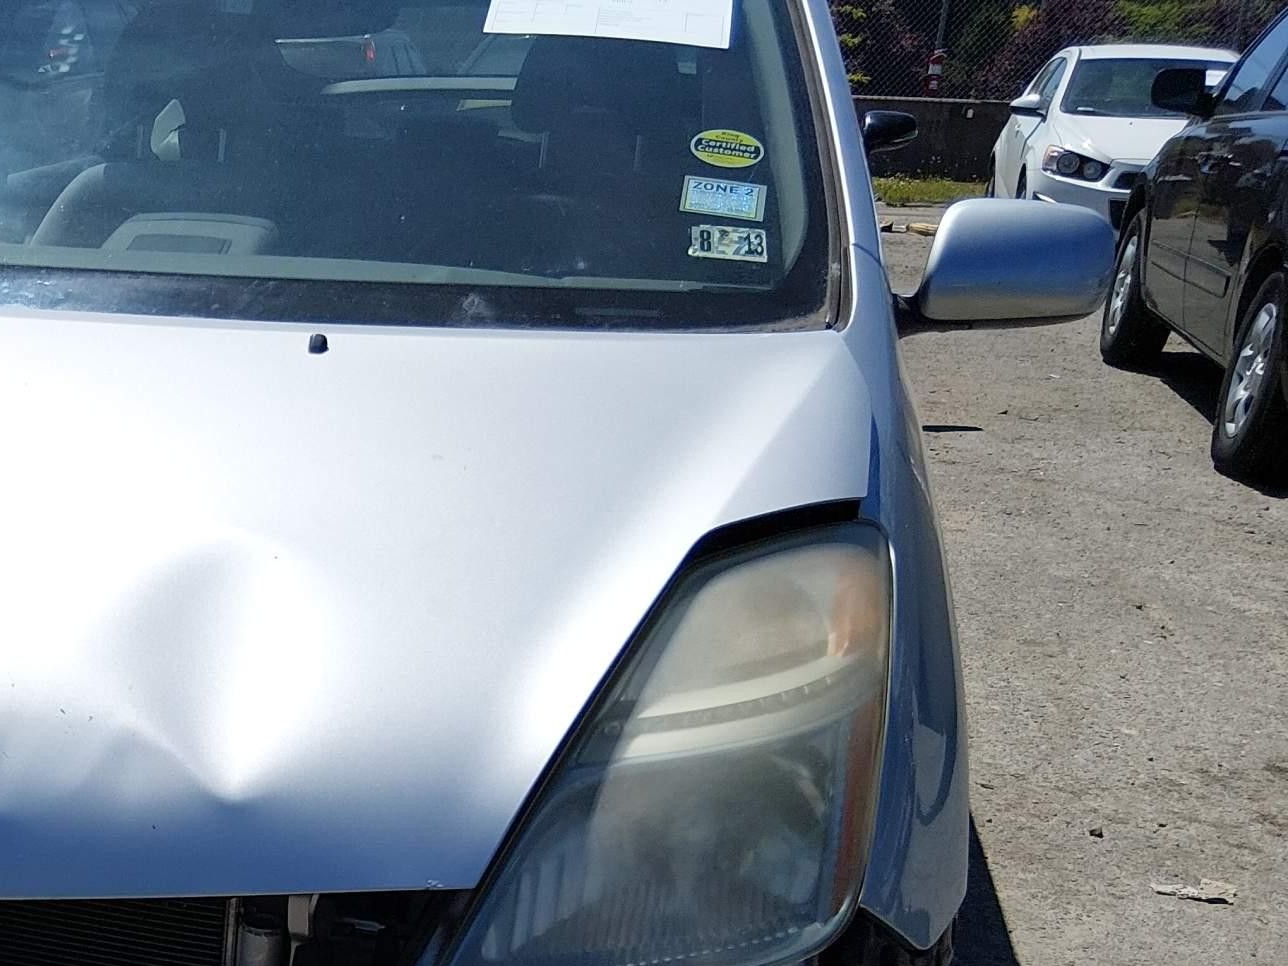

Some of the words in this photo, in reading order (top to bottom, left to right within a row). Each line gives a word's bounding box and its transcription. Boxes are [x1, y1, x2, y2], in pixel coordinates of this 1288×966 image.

[697, 145, 757, 158] Customer
[702, 139, 755, 152] Certified
[692, 181, 740, 194] ZONE
[744, 187, 754, 196] 2
[699, 229, 712, 252] 8
[743, 232, 765, 256] 13
